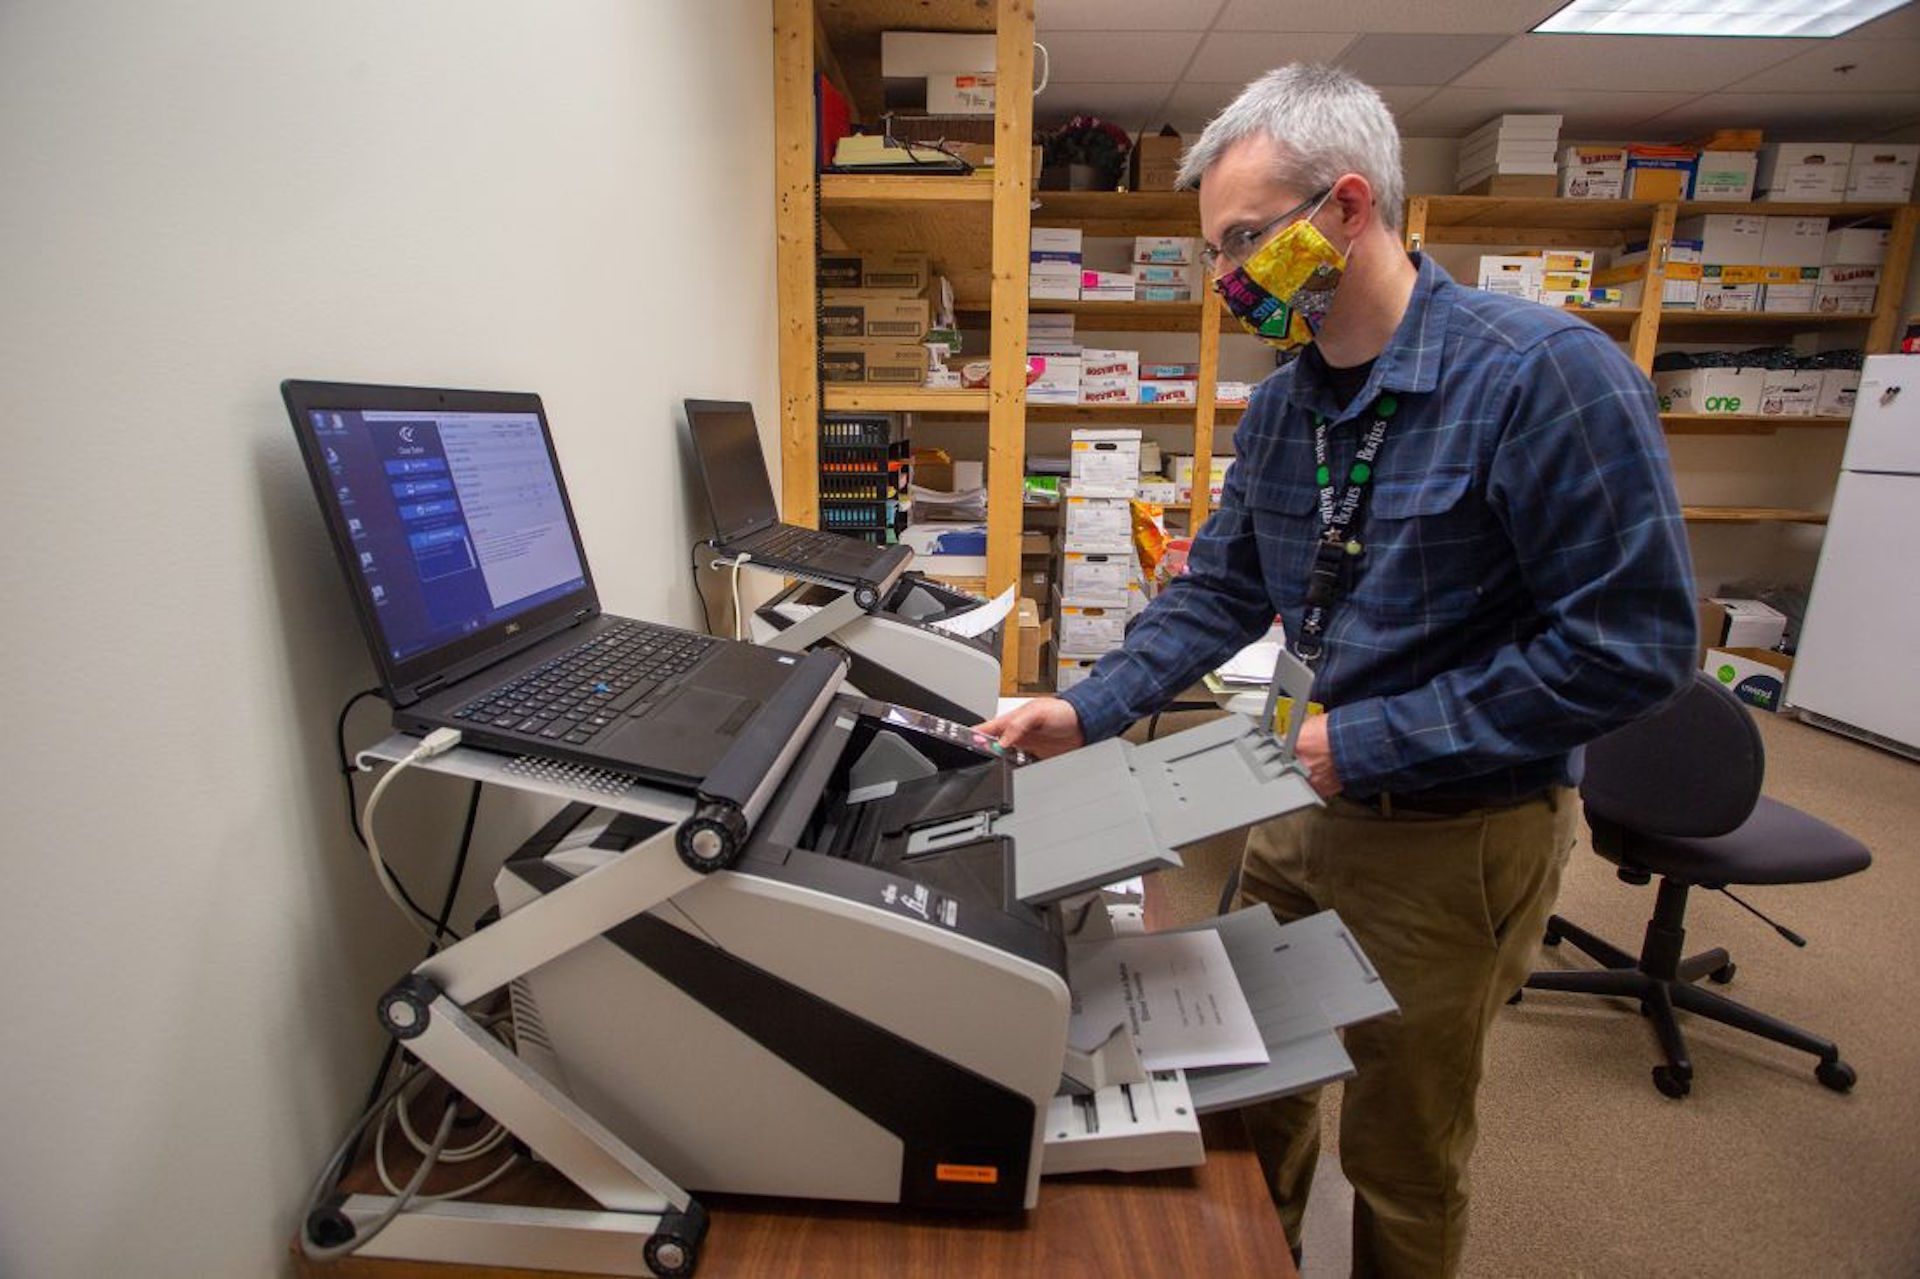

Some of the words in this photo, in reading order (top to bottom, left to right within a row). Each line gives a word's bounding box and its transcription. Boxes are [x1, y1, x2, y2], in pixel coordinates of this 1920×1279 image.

[1705, 396, 1741, 412] one
[1356, 420, 1387, 462] BEATLES
[1332, 486, 1361, 525] BEATLES
